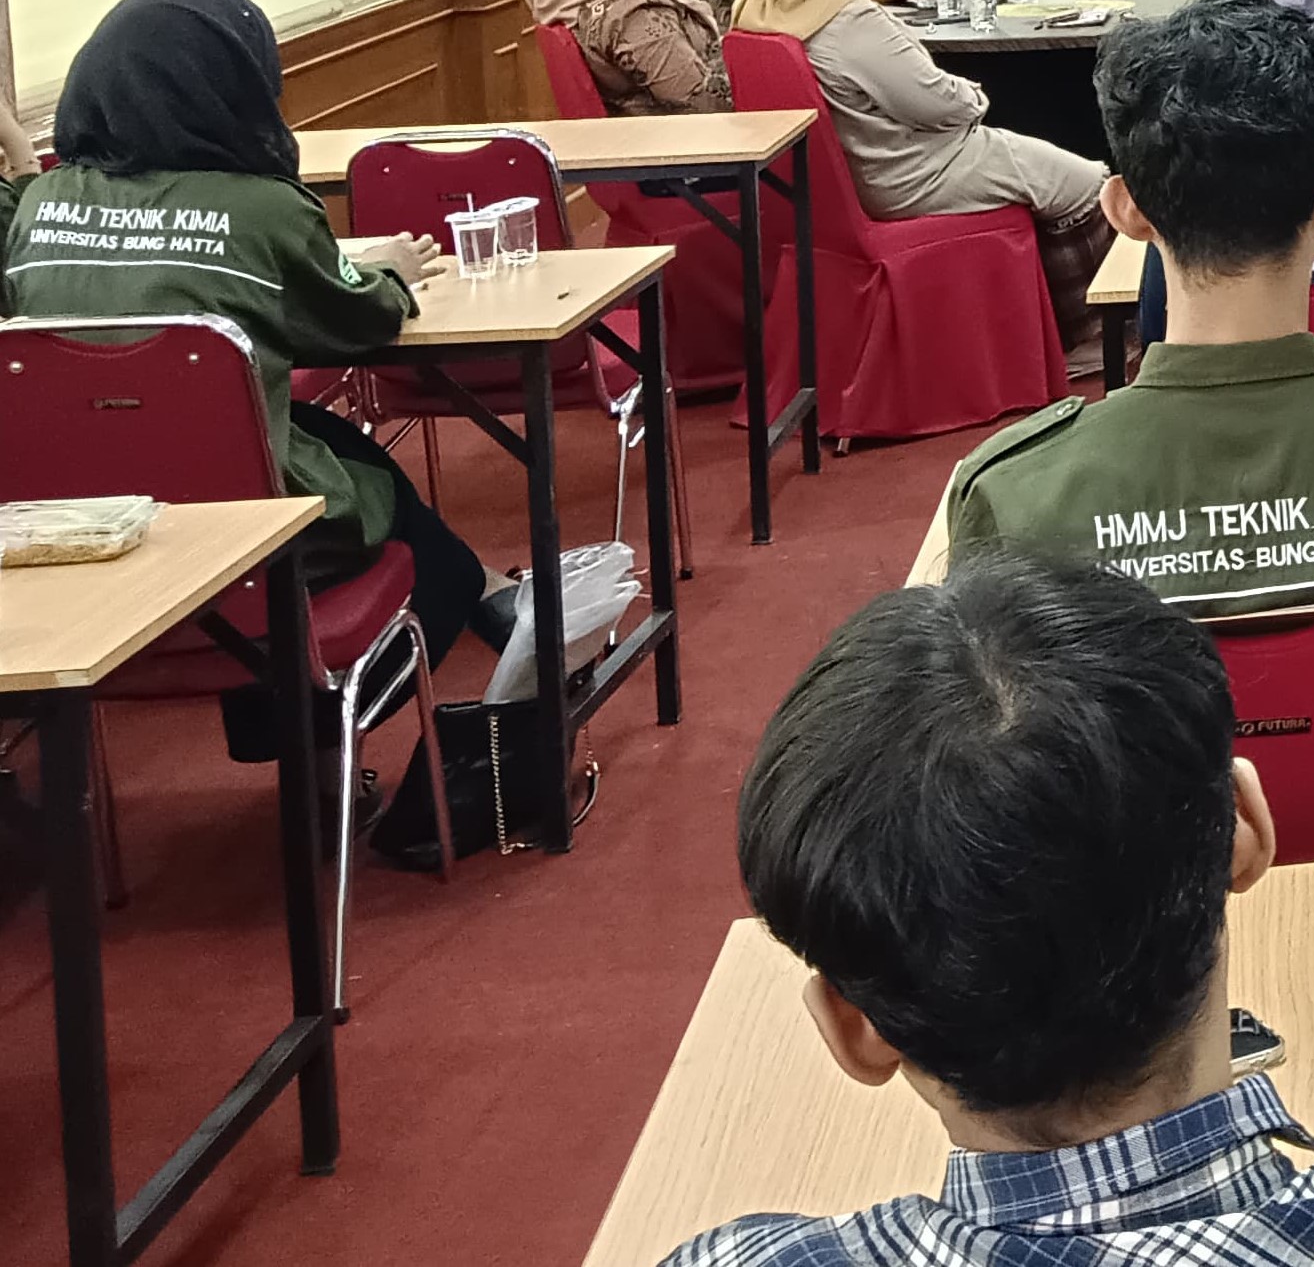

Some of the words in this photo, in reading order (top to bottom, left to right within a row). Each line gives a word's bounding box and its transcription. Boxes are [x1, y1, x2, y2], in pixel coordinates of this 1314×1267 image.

[35, 201, 91, 225] HMMJ
[100, 207, 167, 230] TEKNIK
[172, 209, 231, 235] KIMIA
[30, 229, 118, 250] UNIVERSITAS
[123, 236, 165, 251] BUNG
[170, 236, 225, 256] HATTA
[1094, 509, 1187, 549] HMMJ
[1201, 497, 1310, 537] TEKNIK
[1258, 719, 1306, 731] FUTURA
